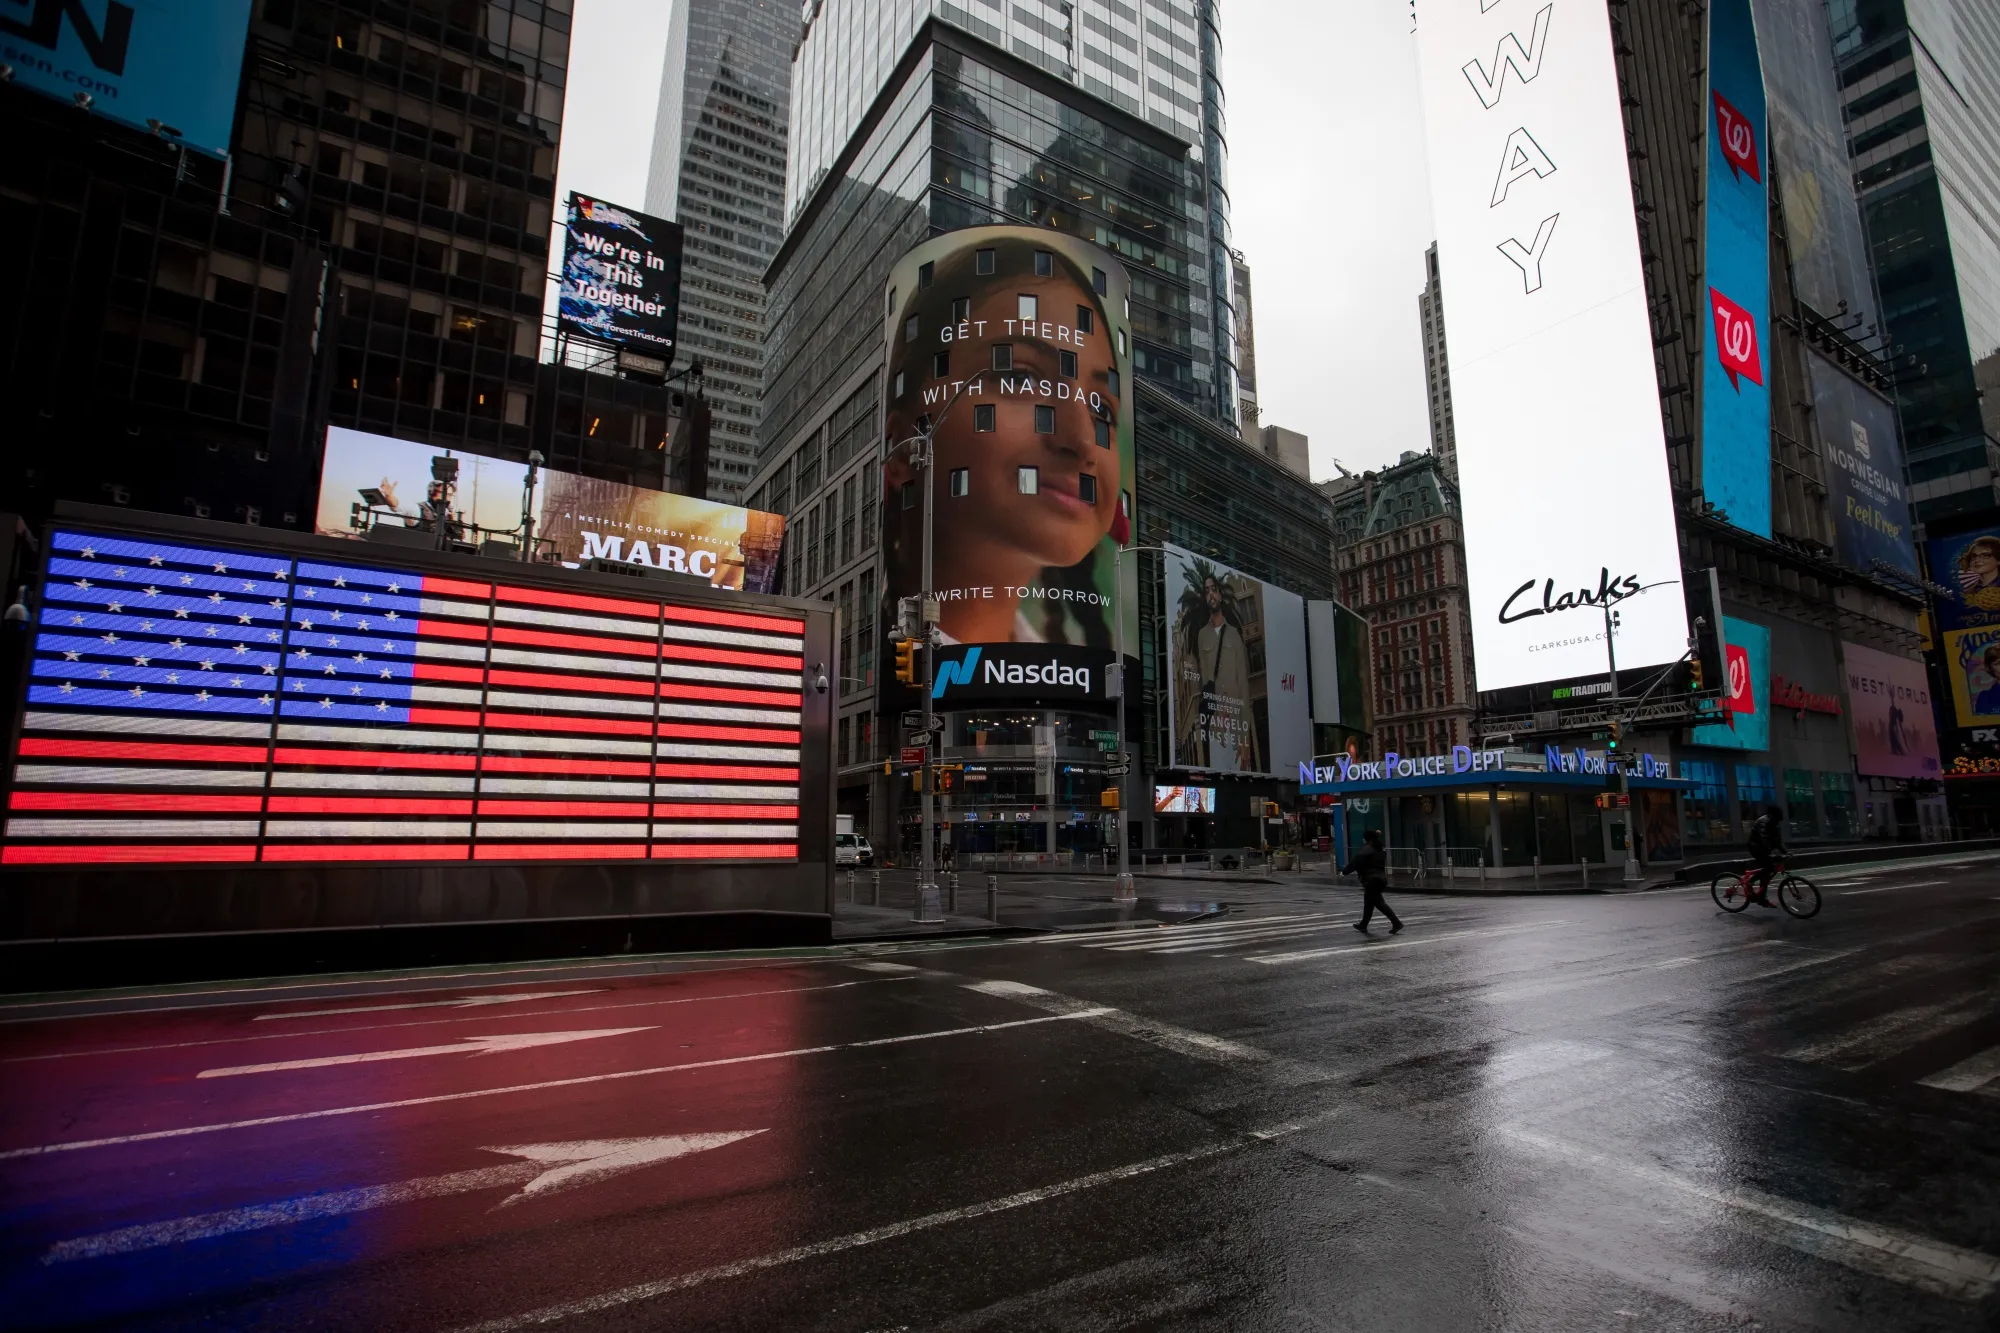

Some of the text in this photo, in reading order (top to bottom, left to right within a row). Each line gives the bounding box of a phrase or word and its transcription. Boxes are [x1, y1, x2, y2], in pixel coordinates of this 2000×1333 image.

[584, 232, 665, 272] We're in
[604, 262, 644, 289] This
[575, 279, 667, 318] Together
[561, 312, 673, 347] www.RainforestTrust.org
[940, 319, 1086, 348] GET THERE
[923, 377, 1102, 411] WITH NASDAQ
[1827, 442, 1900, 501] NORWEGIAN
[579, 515, 631, 529] NETFLIX
[637, 529, 684, 543] COMEDY
[690, 538, 735, 552] SPECIAL
[1846, 495, 1901, 539] Feel Free
[578, 530, 717, 578] MARC
[1004, 586, 1112, 608] TOMORROW
[1498, 566, 1642, 624] Clarks
[984, 658, 1090, 693] Nasdaq
[1203, 691, 1244, 706] SPRING FASHION
[1207, 702, 1234, 713] SELECTED
[1200, 713, 1249, 732] D'ANGELO
[1200, 729, 1250, 747] RUSSELL
[1300, 745, 1505, 785] NEW YORK POLICE DEPT
[1545, 743, 1575, 773] NEW
[1574, 747, 1606, 775] YORK
[1642, 753, 1670, 779] DEPT
